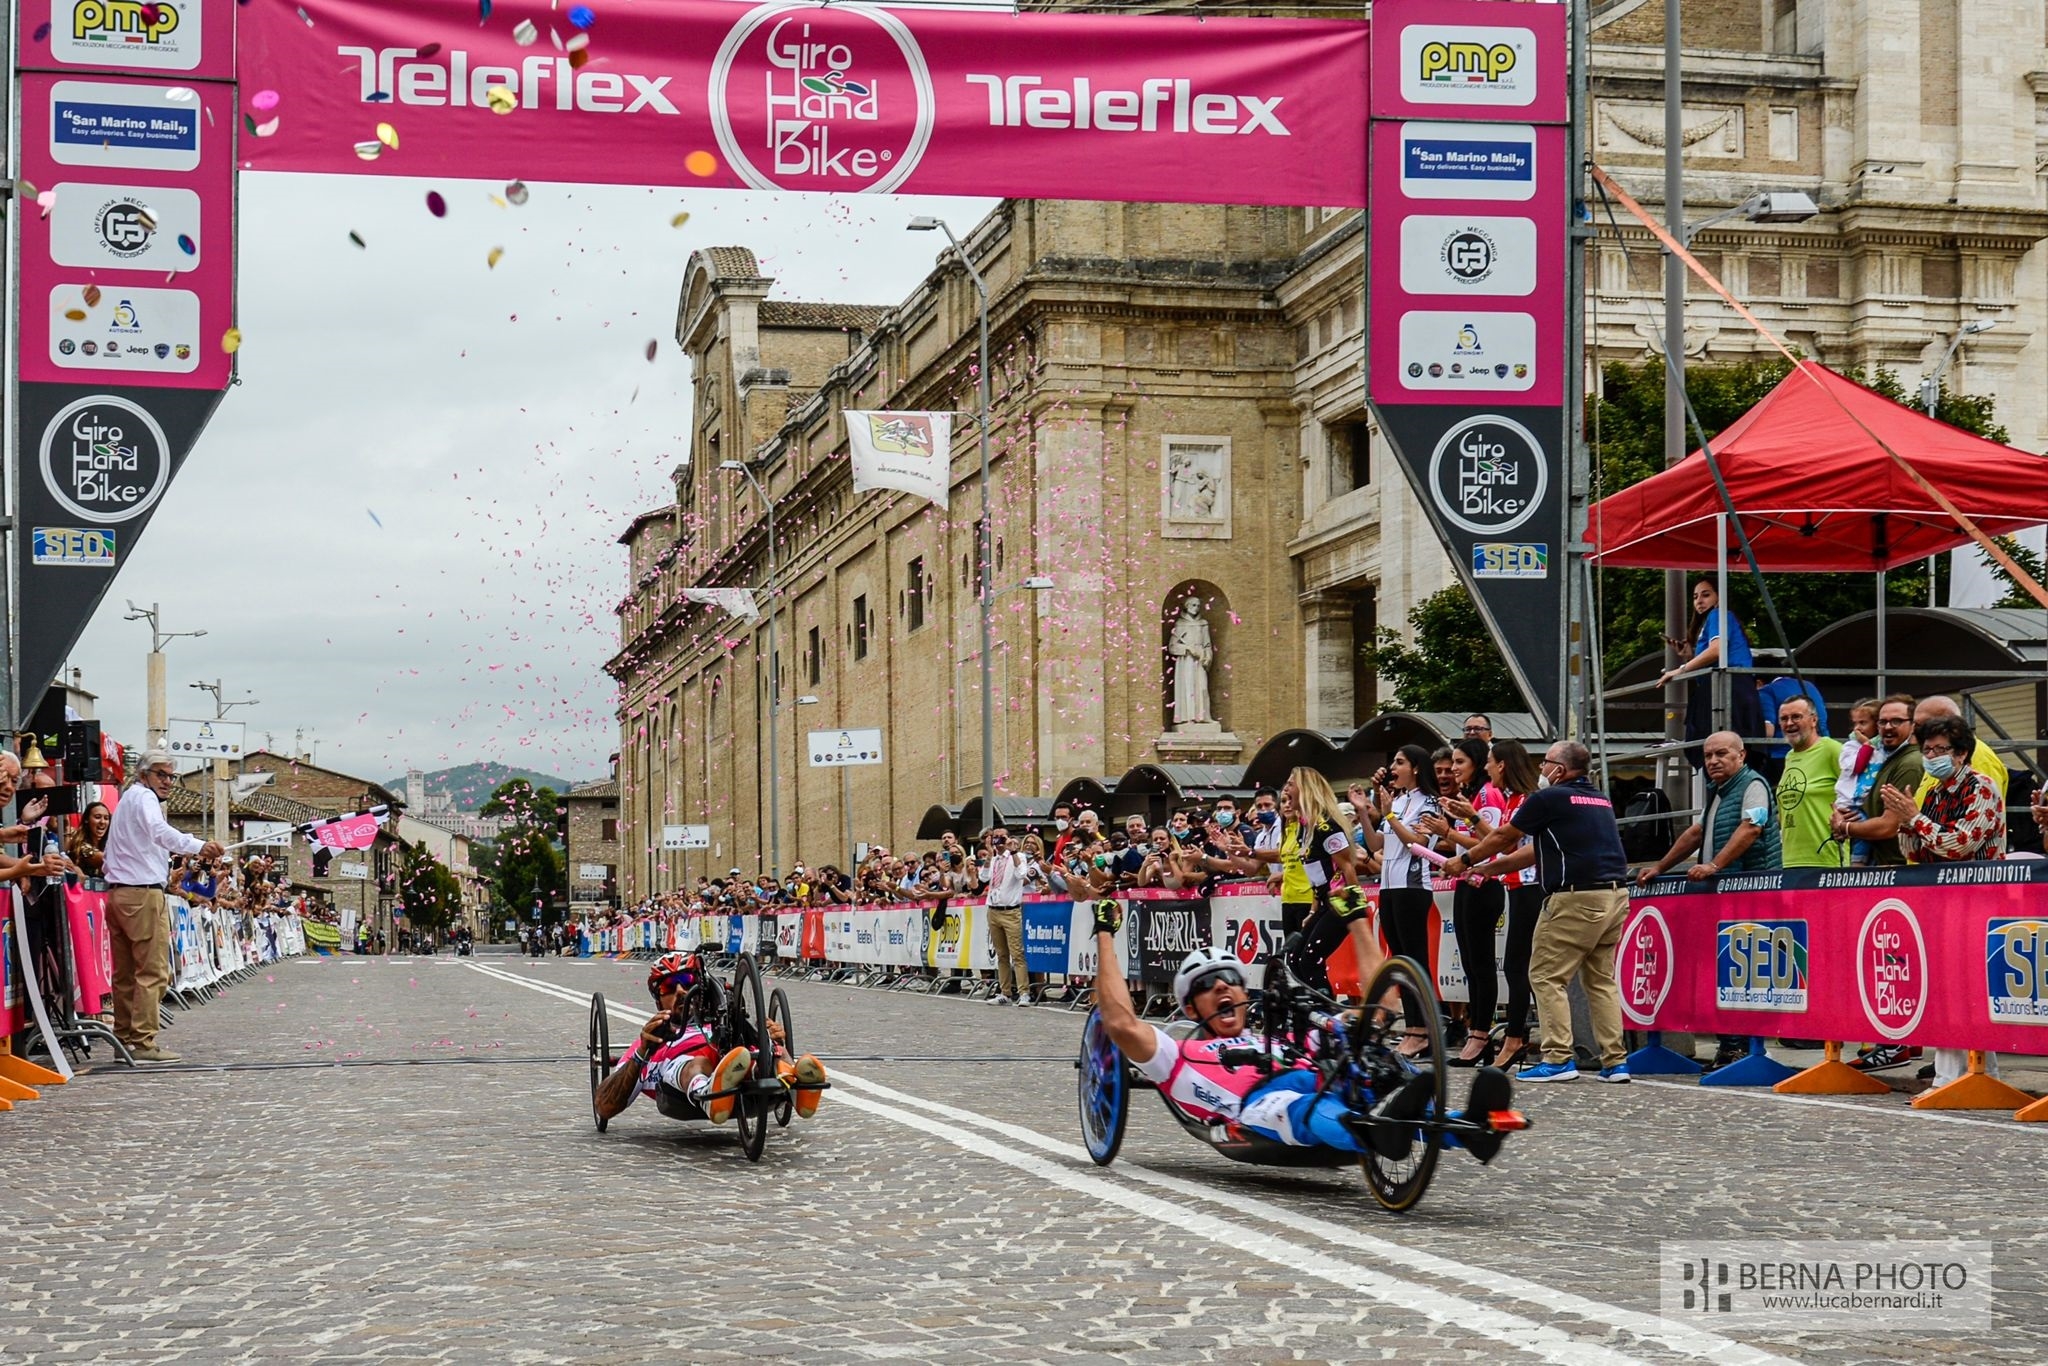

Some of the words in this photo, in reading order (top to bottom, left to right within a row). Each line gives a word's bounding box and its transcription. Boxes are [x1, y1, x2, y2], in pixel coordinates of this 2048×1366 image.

[73, 0, 179, 43] pmp
[766, 17, 852, 70] Giro
[1421, 42, 1516, 82] pmp
[338, 46, 681, 115] Teleflex
[766, 71, 878, 148] Hand
[966, 74, 1291, 135] Teleflex
[90, 129, 126, 137] deliveries.
[128, 131, 144, 139] Easy
[146, 132, 179, 140] business.
[101, 116, 147, 129] Marino
[775, 120, 878, 177] Bike
[1446, 152, 1488, 162] Marino
[94, 199, 117, 234] OFFICINA
[108, 243, 152, 258] PRECISIONE
[1440, 229, 1461, 262] OFFICINA
[1467, 226, 1498, 262] MECCANICA
[1453, 269, 1494, 284] PRECISIONE
[126, 345, 149, 355] Jeep
[1469, 366, 1490, 375] Jeep
[73, 412, 123, 441] Giro
[1459, 431, 1505, 458] Giro
[73, 441, 137, 486] Hand
[78, 470, 138, 501] Bike
[1459, 459, 1518, 500] Hand
[1463, 486, 1518, 514] Bike
[45, 531, 103, 556] SEO
[1484, 546, 1537, 570] SEO
[1717, 874, 1783, 894] @GIROHANDBIKE
[1819, 871, 1897, 887] #GIROHANDBIKE
[1937, 865, 2031, 884] #CAMPIONIDIVITA
[1144, 911, 1205, 951] ASTORIA
[1636, 922, 1653, 949] Giro
[1873, 918, 1900, 949] Giro
[1632, 950, 1657, 991] Hand
[1729, 927, 1794, 989] SEO
[1633, 976, 1656, 1005] Bike
[1873, 951, 1909, 999] Hand
[1878, 982, 1912, 1016] Bike
